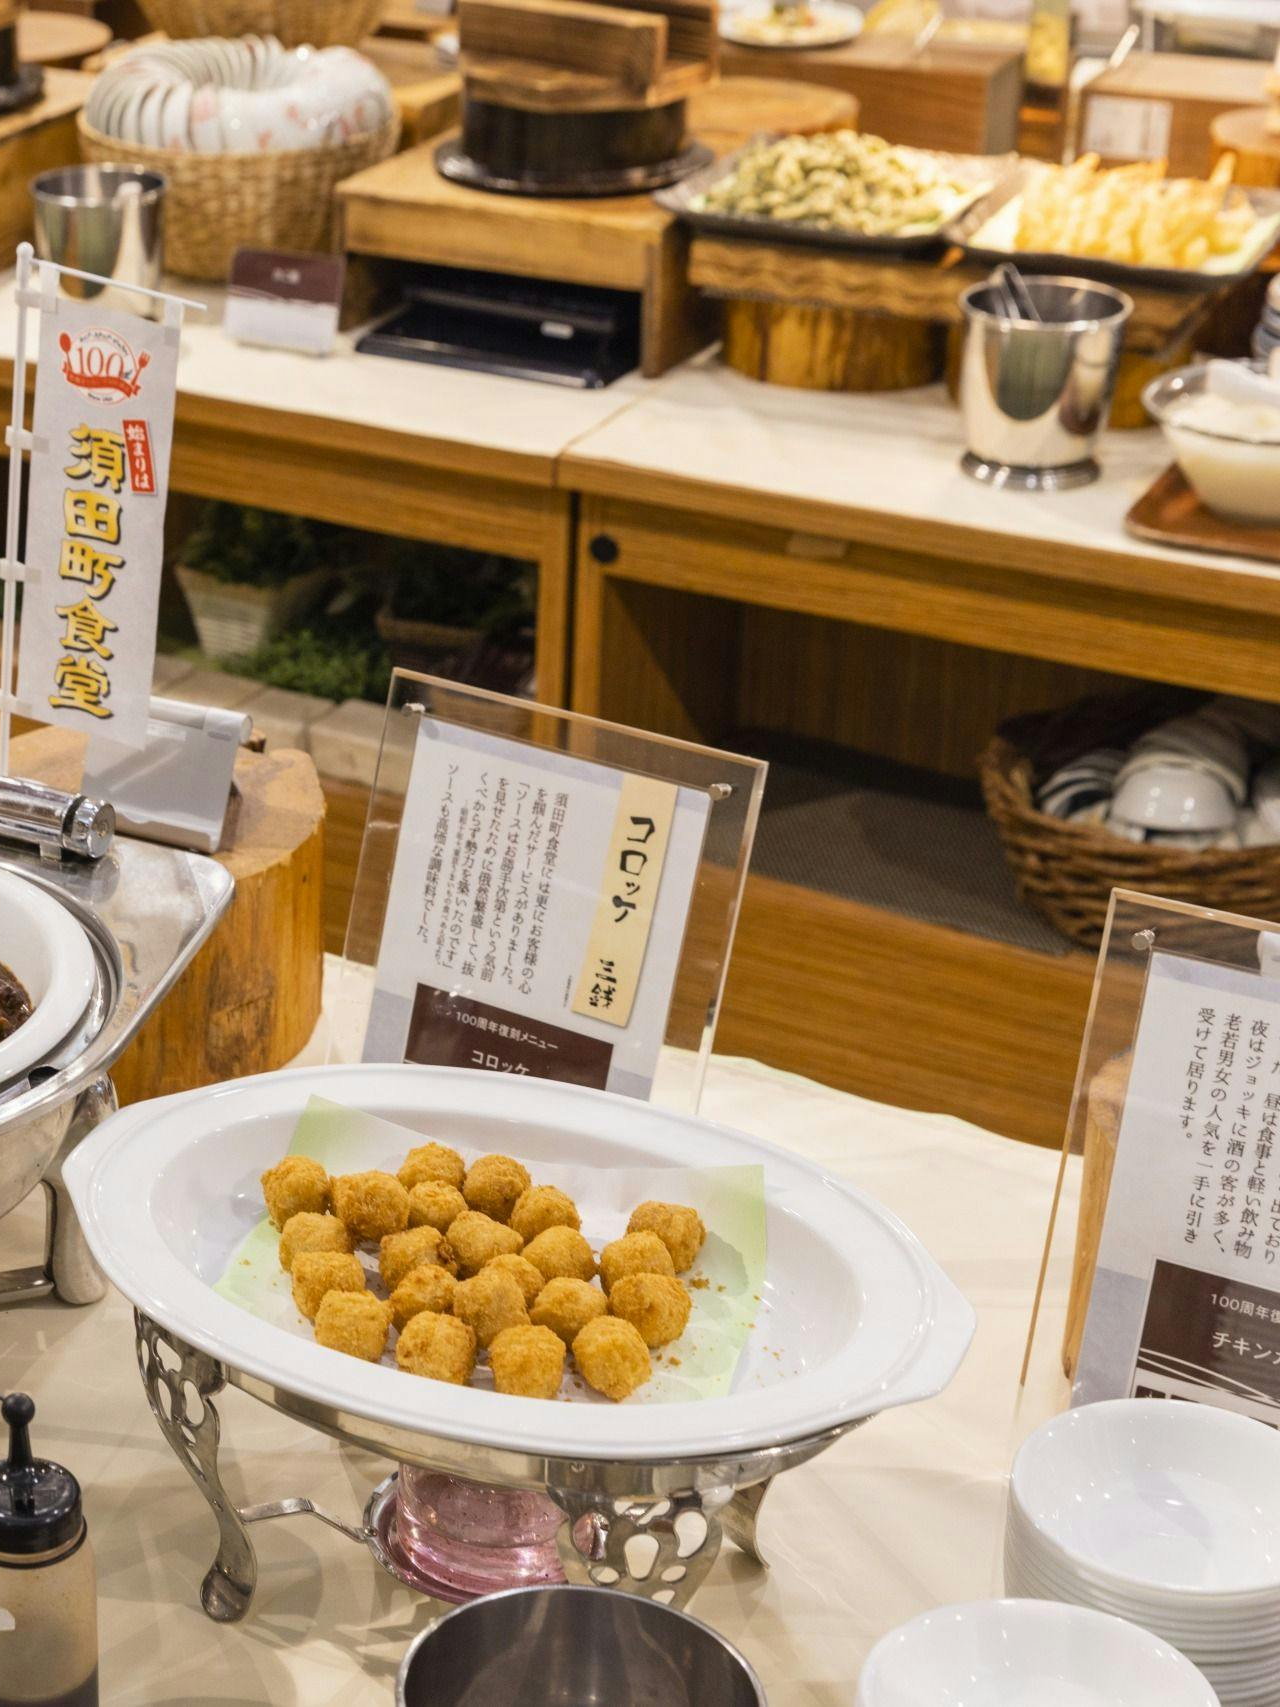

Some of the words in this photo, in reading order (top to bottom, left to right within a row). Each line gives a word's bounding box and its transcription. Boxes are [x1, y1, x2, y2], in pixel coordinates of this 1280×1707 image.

[126, 423, 151, 490] 始まりは
[48, 423, 125, 719] 須田町食堂
[517, 791, 569, 996] 須田町食堂には更にお客様の心
[612, 816, 655, 923] コロッケ
[456, 1010, 559, 1050] 100周年復刻メニュー
[1179, 1007, 1216, 1139] 受けて居ります。
[1184, 1012, 1242, 1244] 老若男女の人気を一手に引き
[1213, 1020, 1271, 1254] 夜はジョッキに酒の客が多く、
